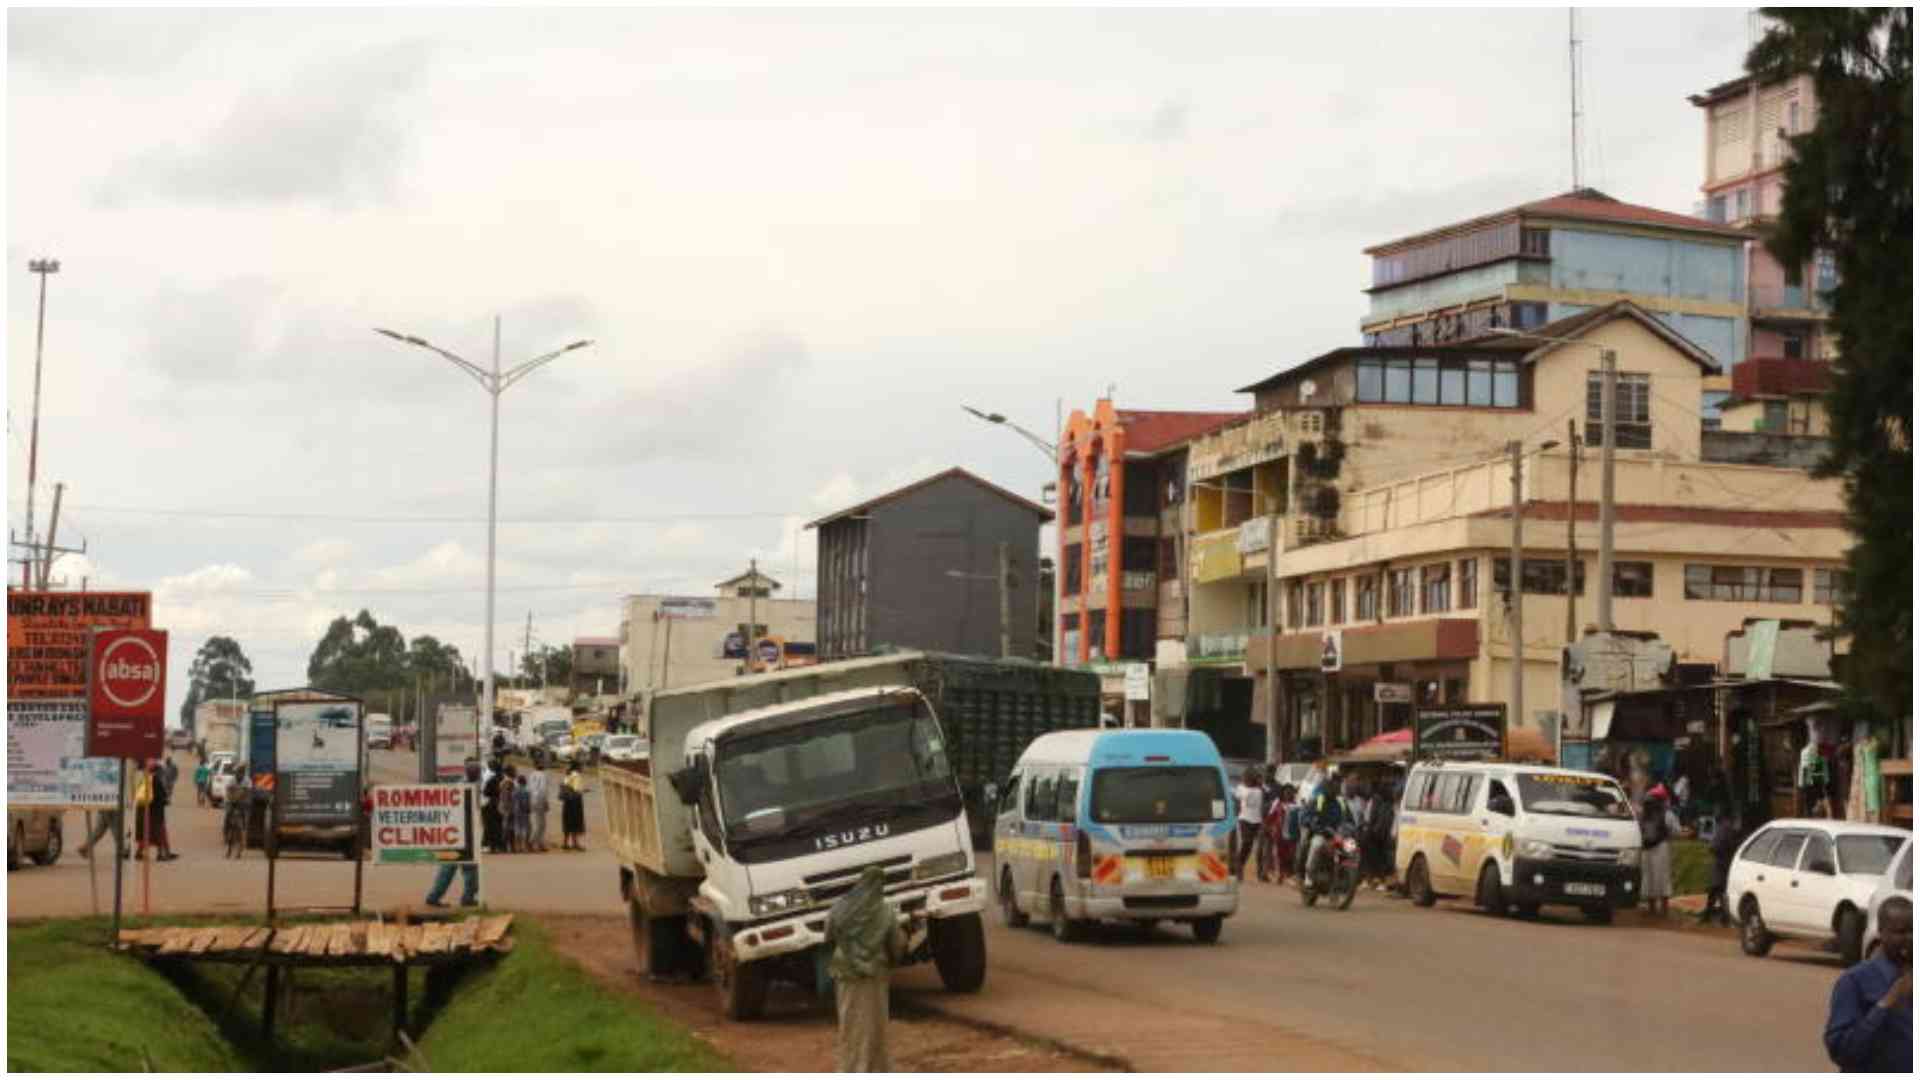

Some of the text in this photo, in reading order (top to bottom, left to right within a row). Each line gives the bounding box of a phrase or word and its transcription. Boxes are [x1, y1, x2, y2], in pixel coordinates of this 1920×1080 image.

[107, 657, 155, 681] absa
[376, 788, 460, 807] ROMMIC
[378, 810, 450, 824] VETERINARY
[378, 826, 459, 845] CLINIC
[815, 823, 889, 849] ISUZU
